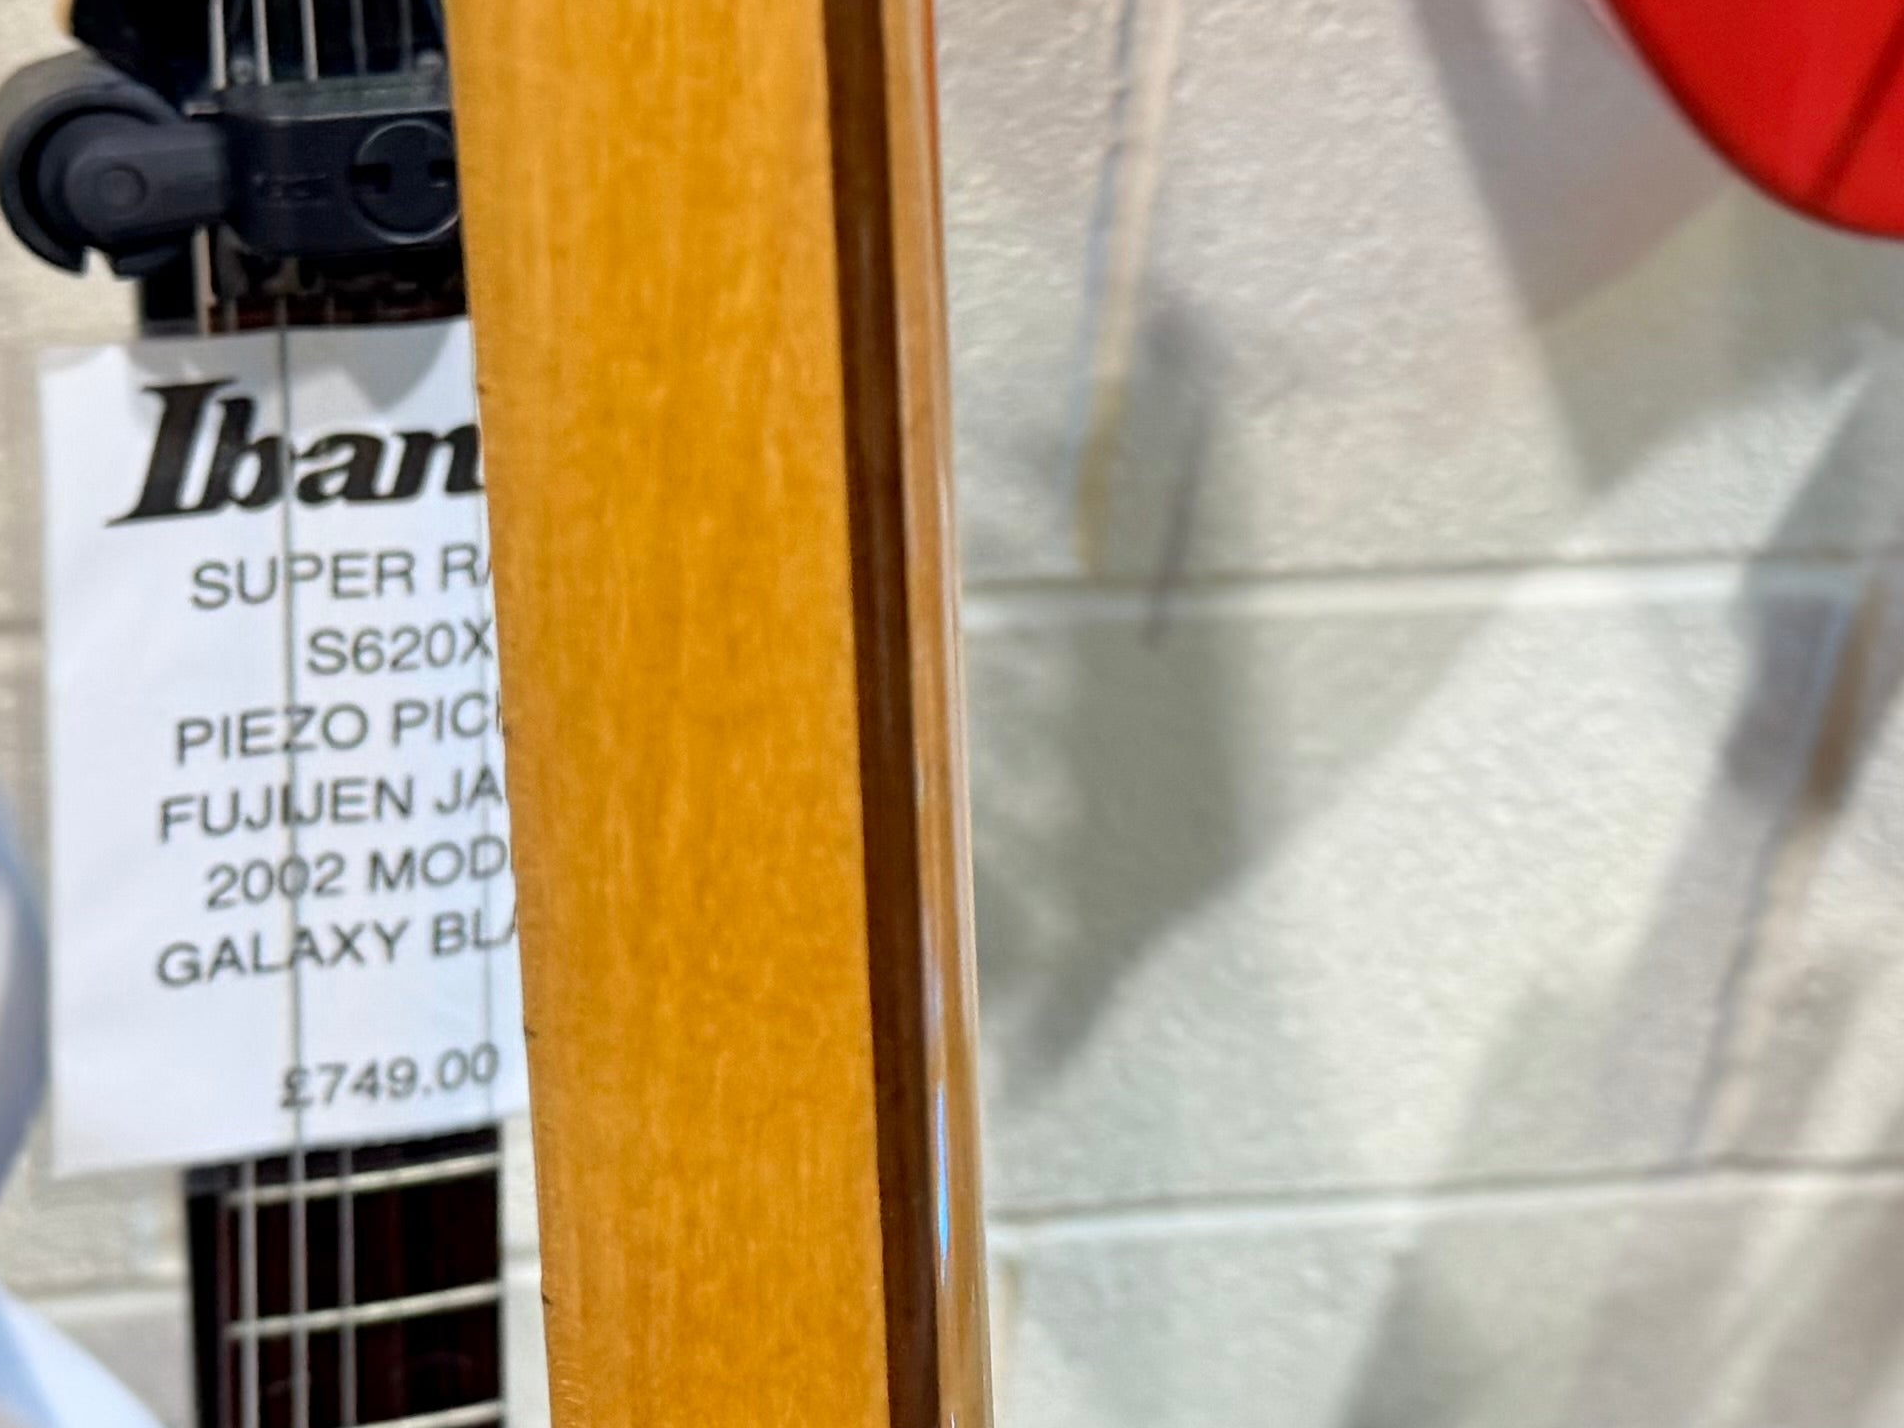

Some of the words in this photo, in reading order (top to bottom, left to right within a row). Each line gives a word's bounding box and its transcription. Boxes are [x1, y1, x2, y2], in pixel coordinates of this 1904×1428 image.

[189, 546, 416, 612] SUPER
[439, 540, 493, 592] R
[306, 616, 494, 678] S620X
[175, 702, 369, 767] PIEZO
[390, 688, 504, 749] PIC
[205, 851, 347, 912] 2002
[156, 918, 411, 990] GALAXY
[431, 907, 517, 959] BL
[280, 1041, 500, 1112] £749.00
